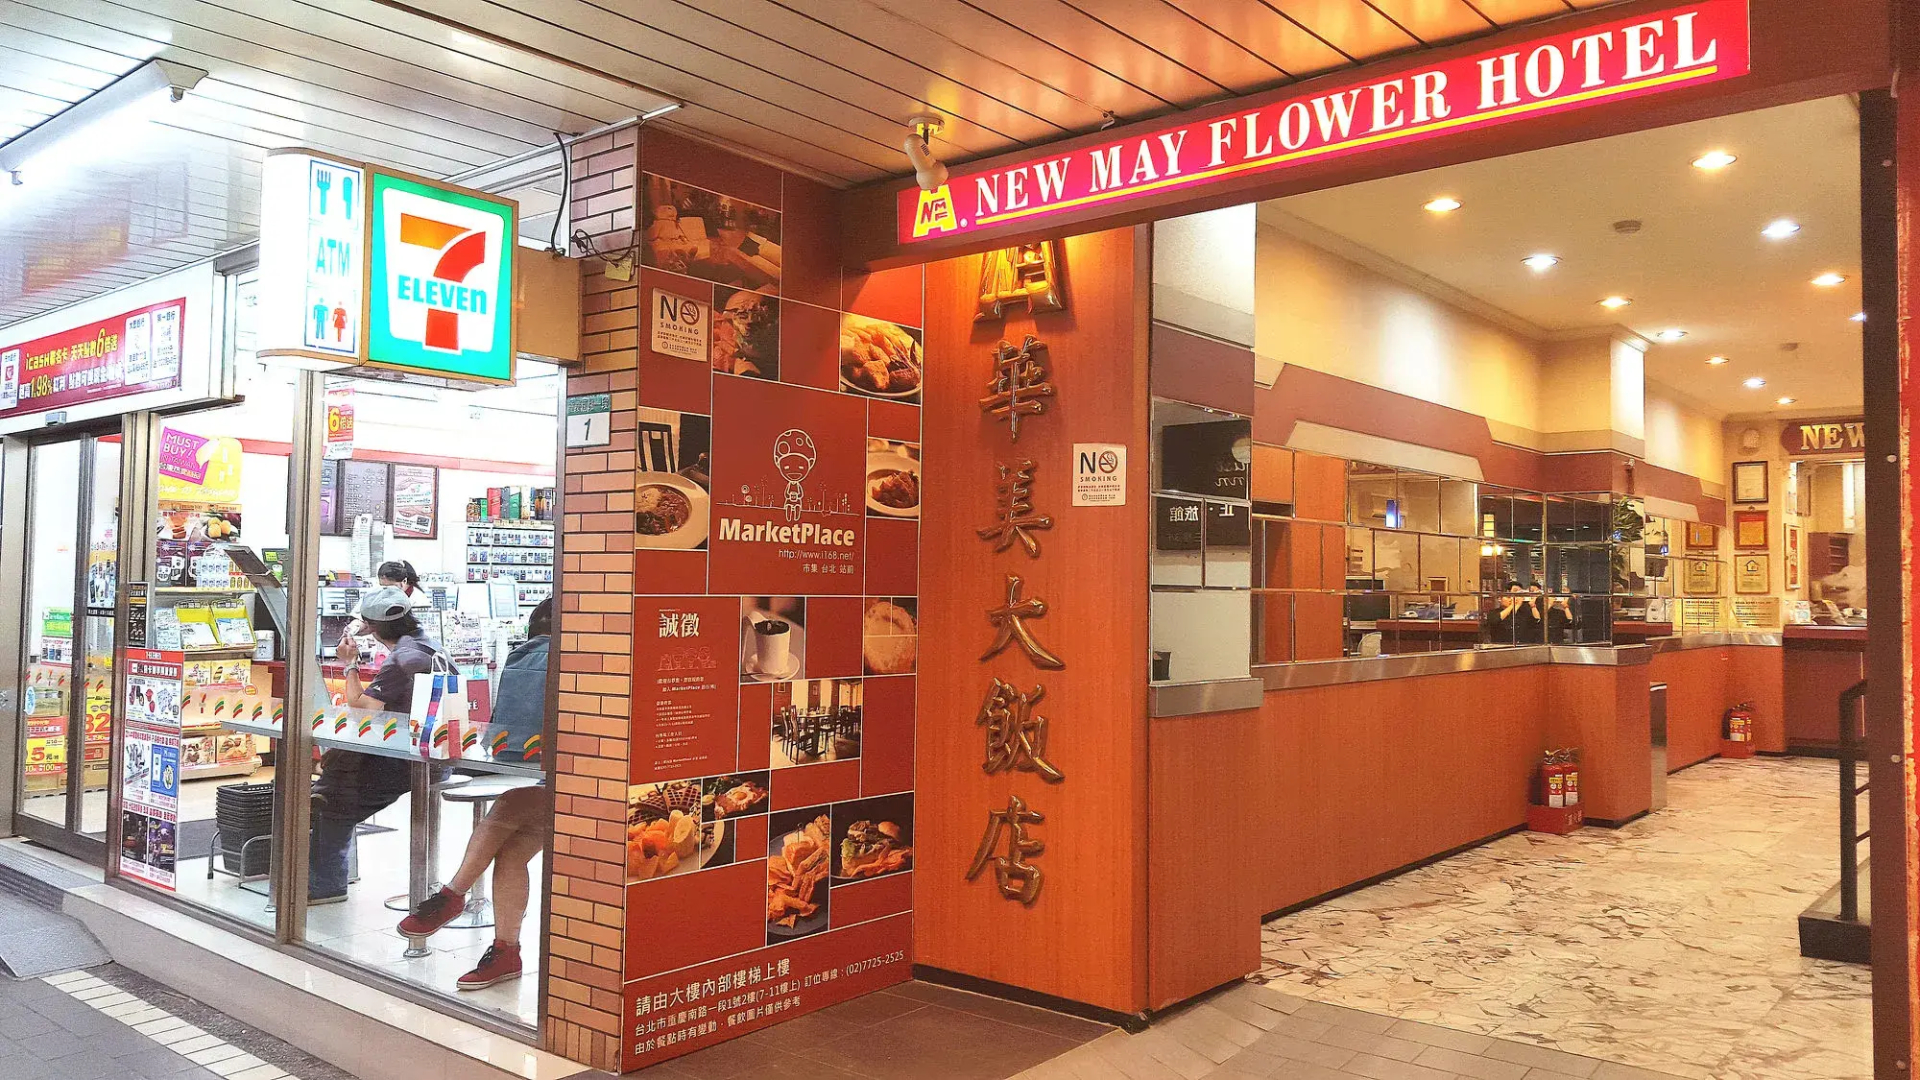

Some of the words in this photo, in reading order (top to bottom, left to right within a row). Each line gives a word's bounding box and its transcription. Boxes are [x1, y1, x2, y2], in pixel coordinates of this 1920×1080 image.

[975, 157, 1071, 216] NEW
[1089, 130, 1189, 192] MAY
[1208, 70, 1451, 168] FLOWER
[1477, 11, 1718, 110] HOTEL
[315, 236, 350, 277] ATM
[660, 321, 699, 335] SMOKING
[166, 432, 199, 450] MUST
[584, 418, 591, 441] 1
[719, 517, 855, 546] MarketPlace
[803, 563, 818, 574] 市集
[821, 564, 837, 574] 台北
[659, 612, 700, 638] 誠徵
[966, 334, 1066, 907] 華美大飯店
[635, 958, 790, 1017] 請由大樓內部樓梯上樓
